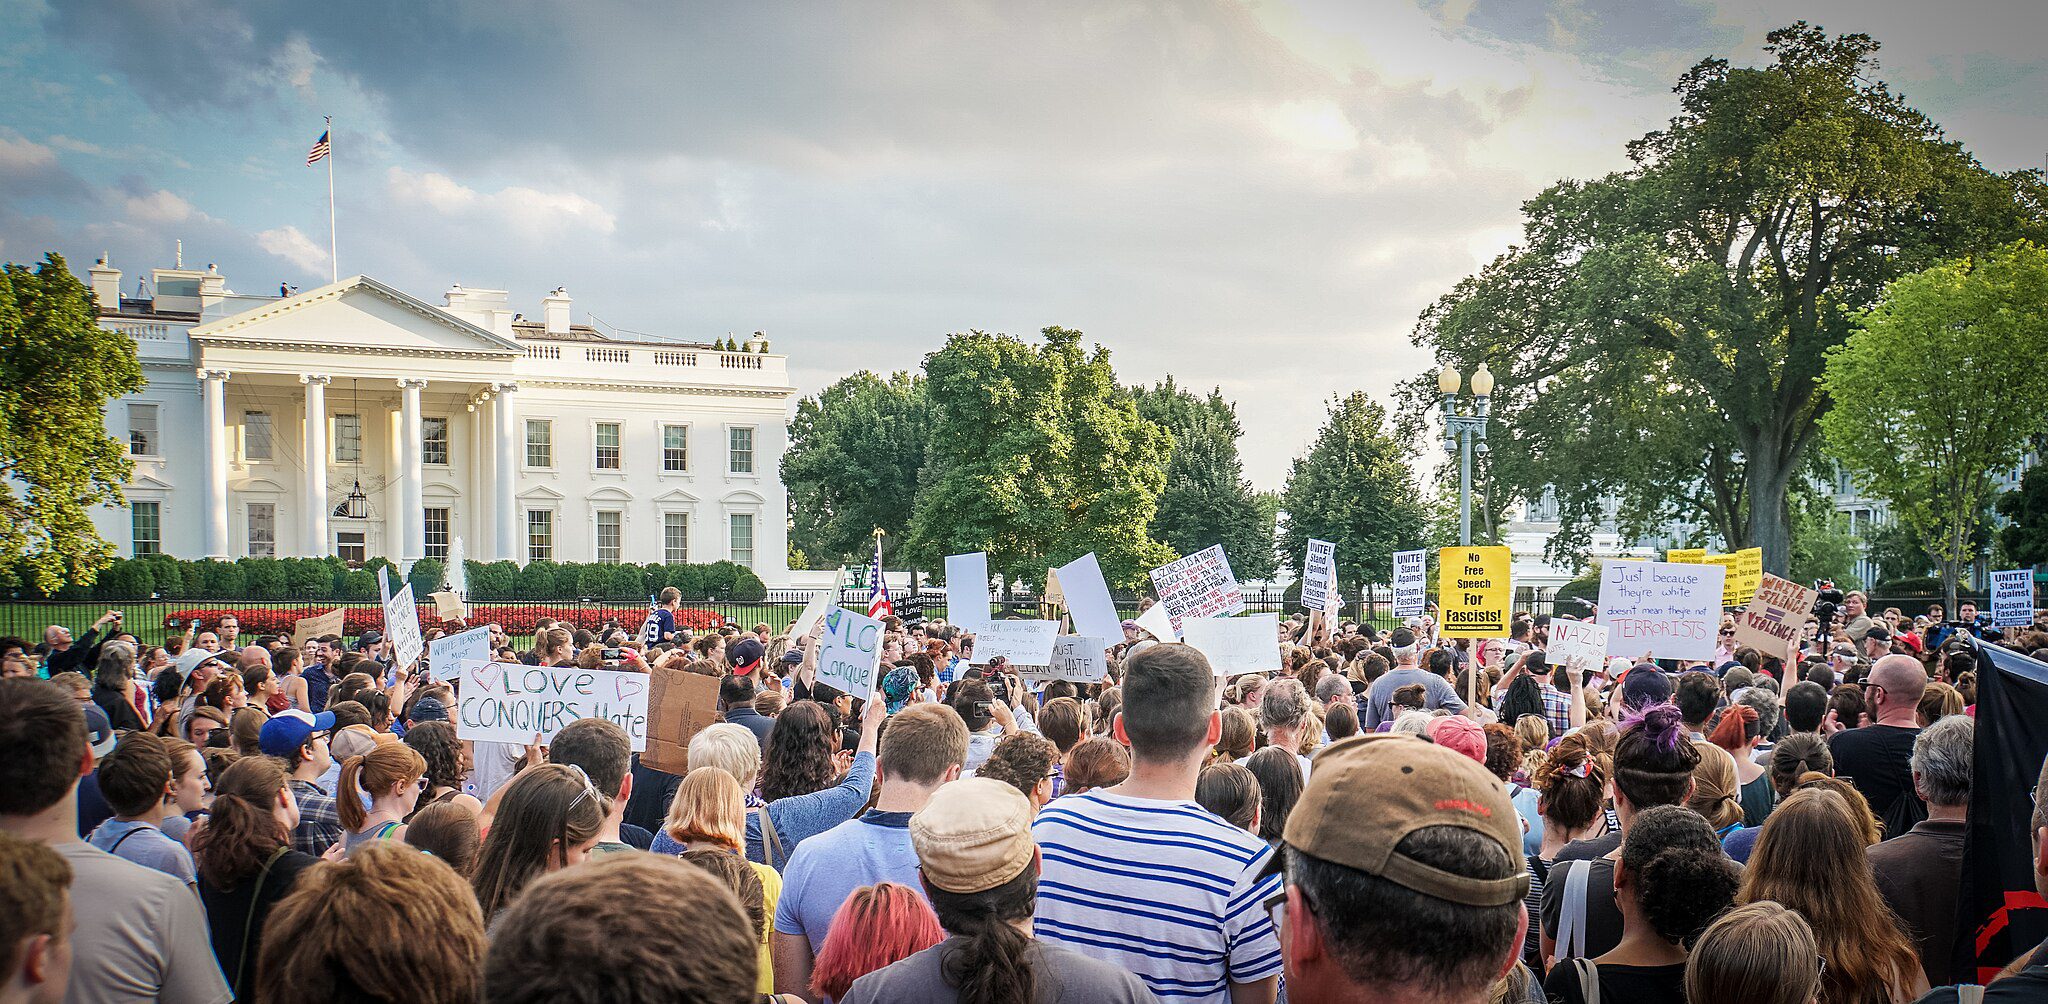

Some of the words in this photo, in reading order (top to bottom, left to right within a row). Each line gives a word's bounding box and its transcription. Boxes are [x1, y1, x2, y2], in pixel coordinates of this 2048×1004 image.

[1310, 542, 1331, 556] UNITE!
[1185, 557, 1194, 568] IS
[1194, 555, 1201, 565] A
[1198, 547, 1217, 562] TRAIT
[1205, 556, 1220, 568] THE
[1309, 553, 1326, 565] Stand
[1397, 553, 1423, 564] UNITE!
[1468, 553, 1480, 562] No
[1212, 563, 1224, 573] THE
[1307, 562, 1328, 576] Against
[1400, 564, 1420, 573] Stand
[1464, 566, 1484, 575] Free
[1397, 573, 1423, 585] Against
[1611, 566, 1643, 584] Just
[1652, 567, 1698, 584] because
[1995, 572, 2029, 583] UNITE!
[1162, 592, 1178, 604] GOOD
[1178, 586, 1192, 598] OLE
[1191, 579, 1206, 591] DAYS
[1205, 572, 1221, 584] THEY
[1190, 587, 1209, 599] TREAT
[1208, 576, 1229, 589] THEM
[1304, 576, 1322, 590] Racism
[1323, 580, 1328, 590] &
[1457, 579, 1491, 589] Speech
[1761, 577, 1807, 601] WHITE
[2000, 581, 2025, 590] Stand
[1304, 585, 1326, 599] Fascism
[1395, 587, 1418, 597] Racism
[1419, 587, 1424, 596] &
[1661, 585, 1691, 598] white
[1996, 588, 2029, 599] Against
[388, 590, 410, 616] WHITE
[905, 596, 923, 606] HOPE
[1168, 603, 1187, 617] VERY
[1187, 595, 1207, 610] ROUGH
[1206, 588, 1223, 600] THEY
[1396, 597, 1423, 606] Fascism
[1464, 593, 1483, 605] For
[1759, 589, 1808, 615] SILENCE
[1994, 601, 2024, 610] Racism
[391, 602, 410, 631] SILENCE
[905, 606, 922, 616] LOVE
[1446, 609, 1502, 622] Fascists!
[1695, 606, 1708, 616] not
[1996, 609, 2030, 618] Fascism
[400, 624, 407, 635] IS
[1610, 618, 1707, 640] TERRORISTS
[1748, 611, 1796, 641] VIOLENCE
[396, 628, 417, 654] WHITE
[1556, 624, 1606, 647] NAZIS
[433, 639, 457, 656] WHITE
[451, 648, 470, 660] MUST
[440, 661, 461, 675] ST
[820, 645, 869, 693] Conque
[461, 697, 582, 734] CONQUERS
[1604, 809, 1620, 833] JUST
